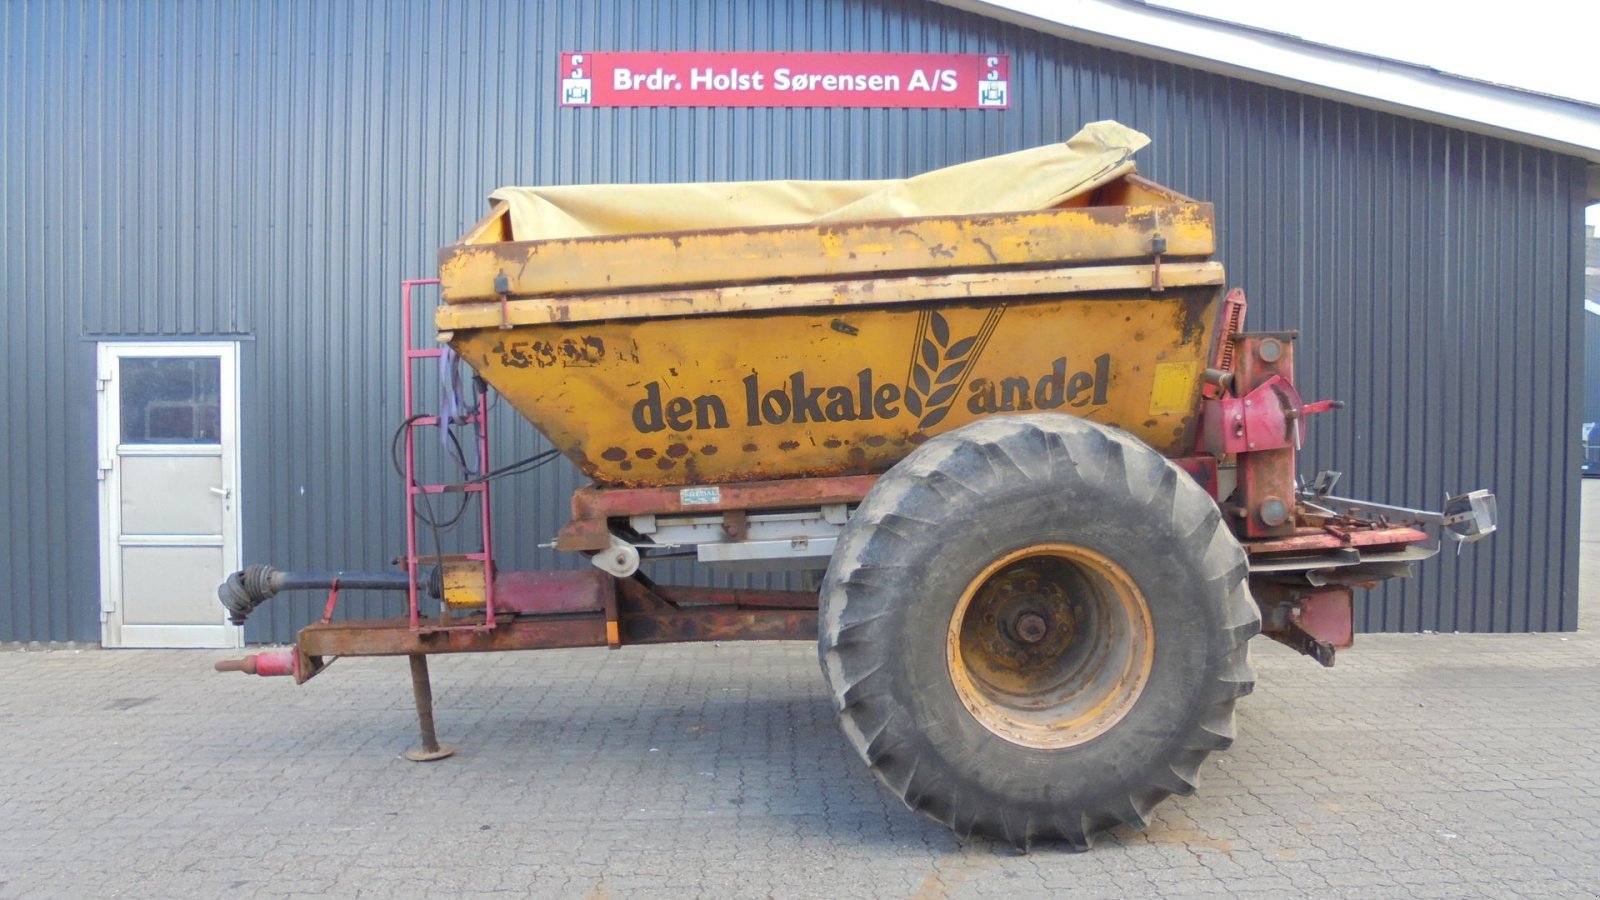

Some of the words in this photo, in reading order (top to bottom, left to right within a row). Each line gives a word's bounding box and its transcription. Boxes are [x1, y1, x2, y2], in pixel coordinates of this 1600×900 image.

[613, 67, 682, 91] Brdr.
[690, 67, 764, 91] Holst
[773, 68, 900, 92] Sørensen
[907, 69, 958, 92] A/S
[632, 381, 730, 433] den
[742, 368, 901, 427] lokale
[967, 353, 1111, 415] andel
